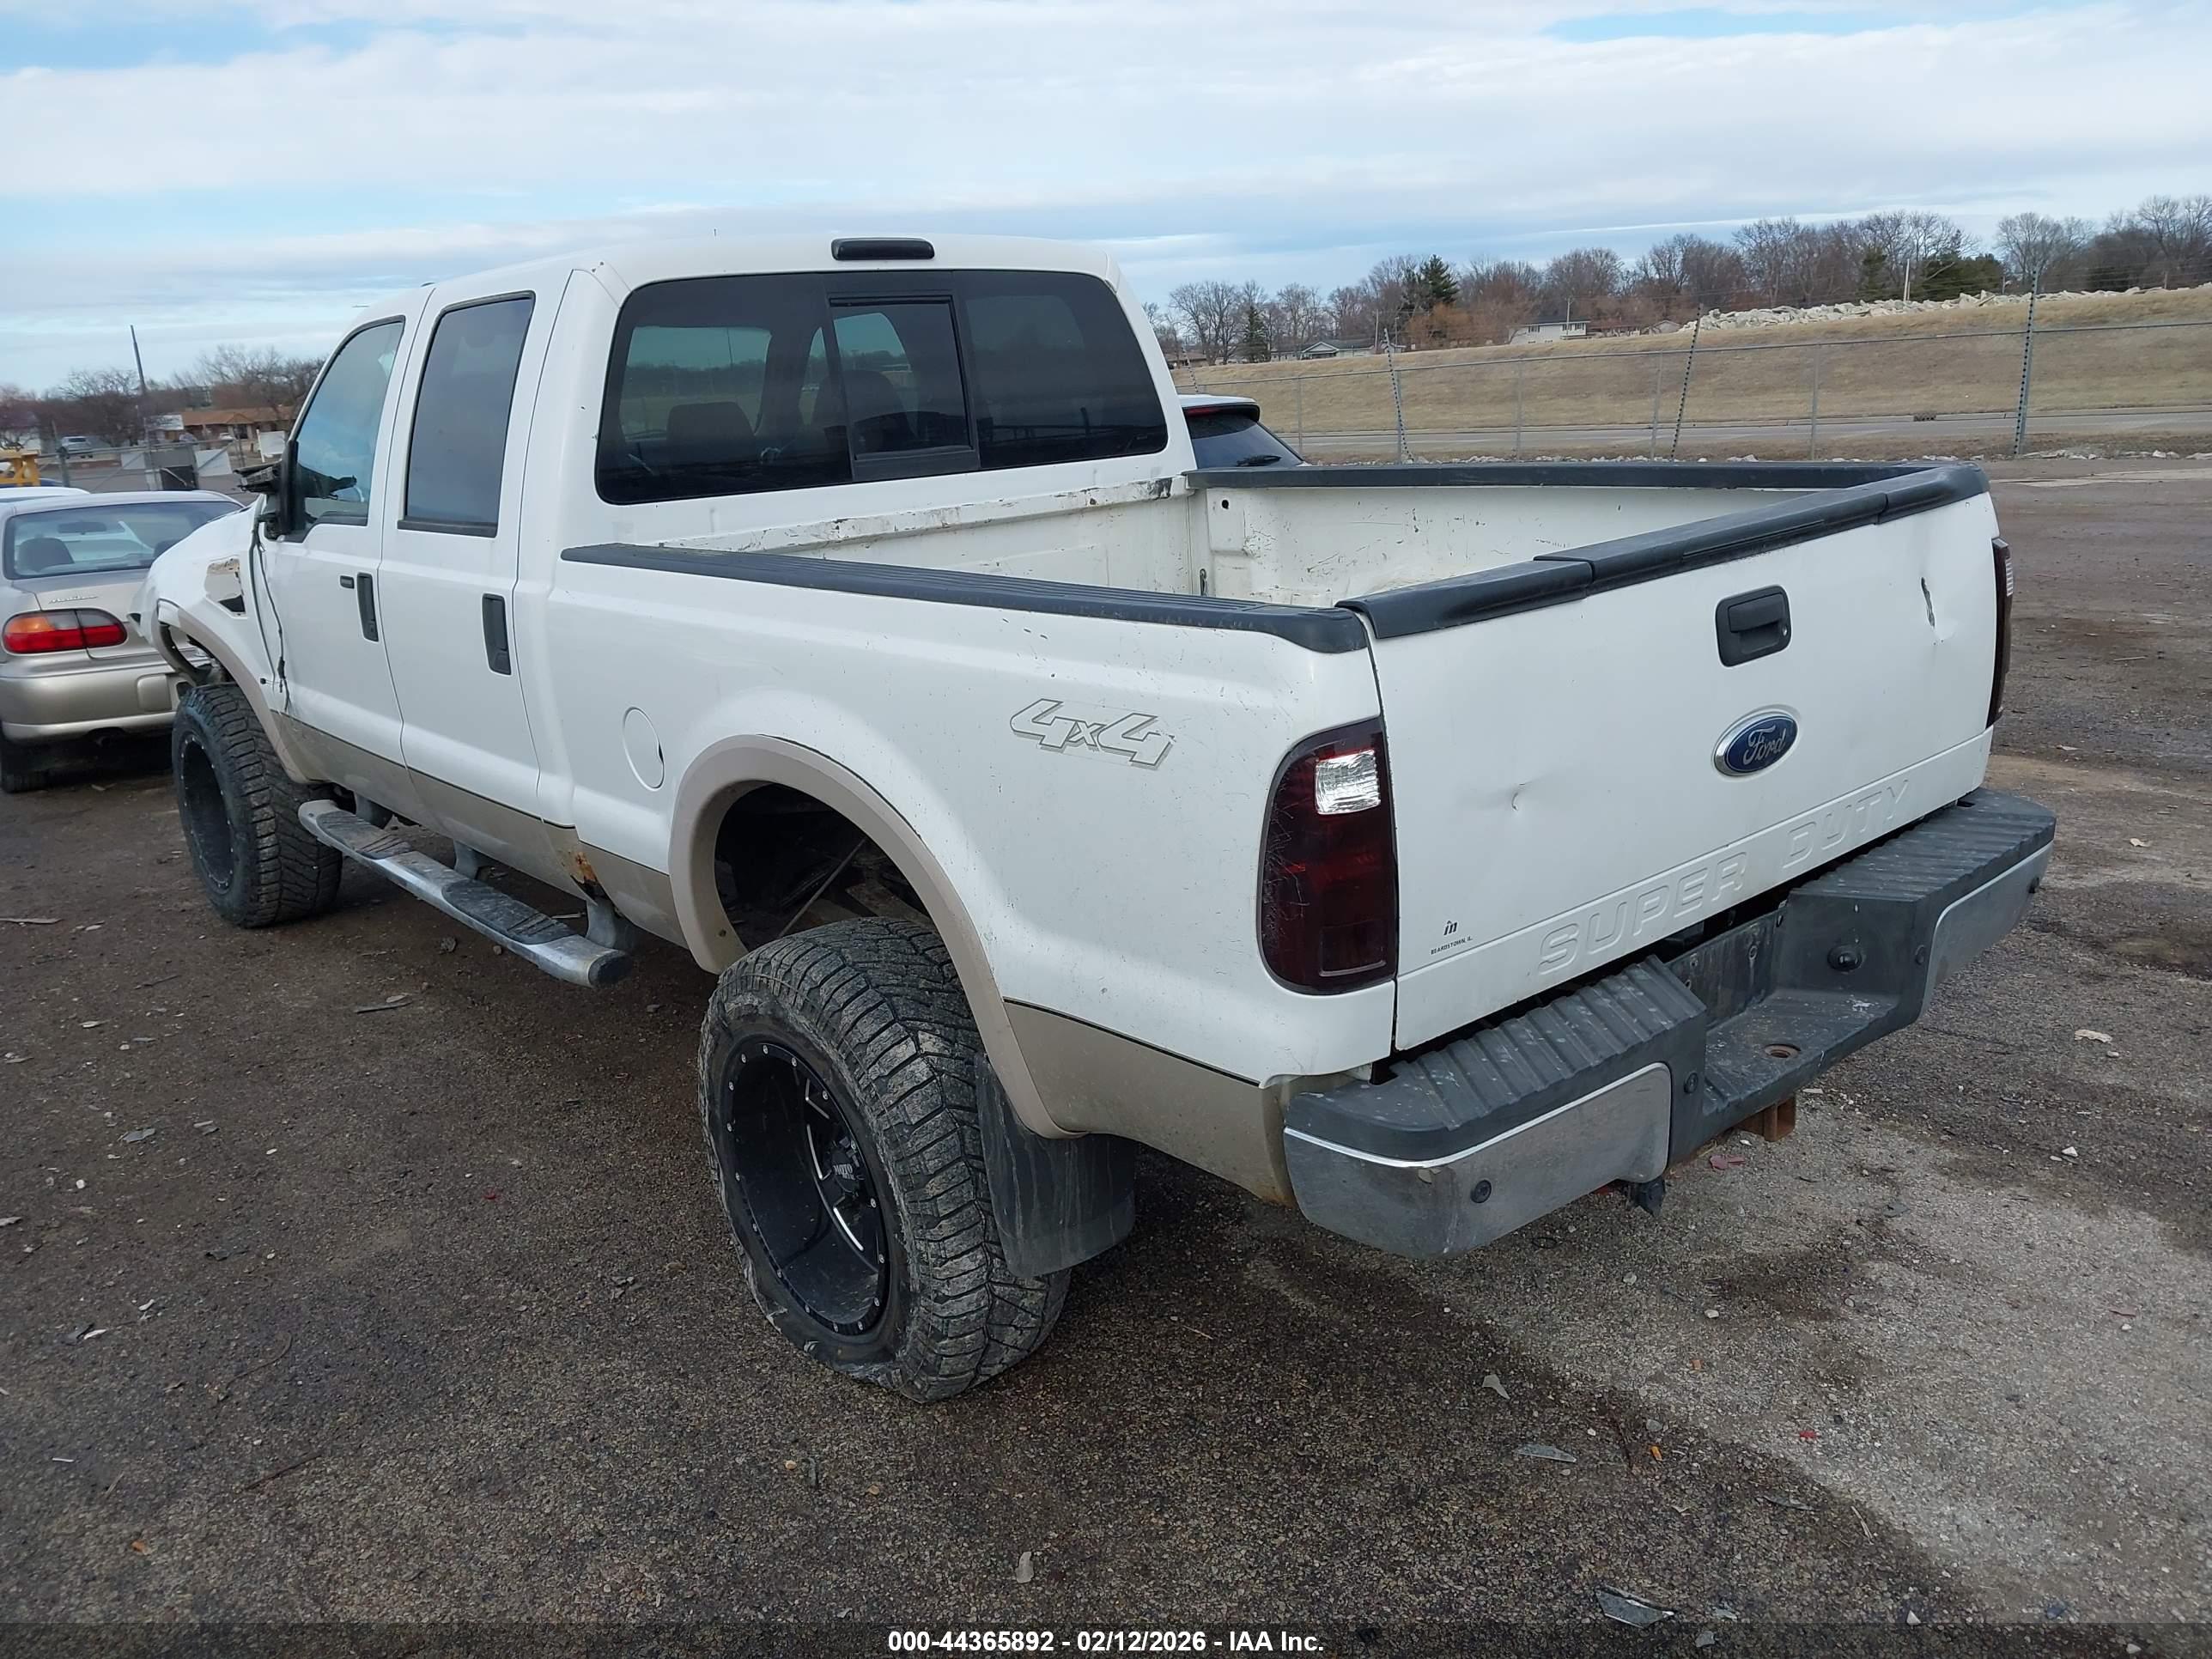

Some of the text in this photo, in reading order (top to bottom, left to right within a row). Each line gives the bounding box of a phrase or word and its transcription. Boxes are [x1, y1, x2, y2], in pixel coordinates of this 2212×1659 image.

[1010, 698, 1176, 771] 4x4
[1742, 725, 1787, 765] Ford
[1539, 779, 1909, 975] SUPER DUTY
